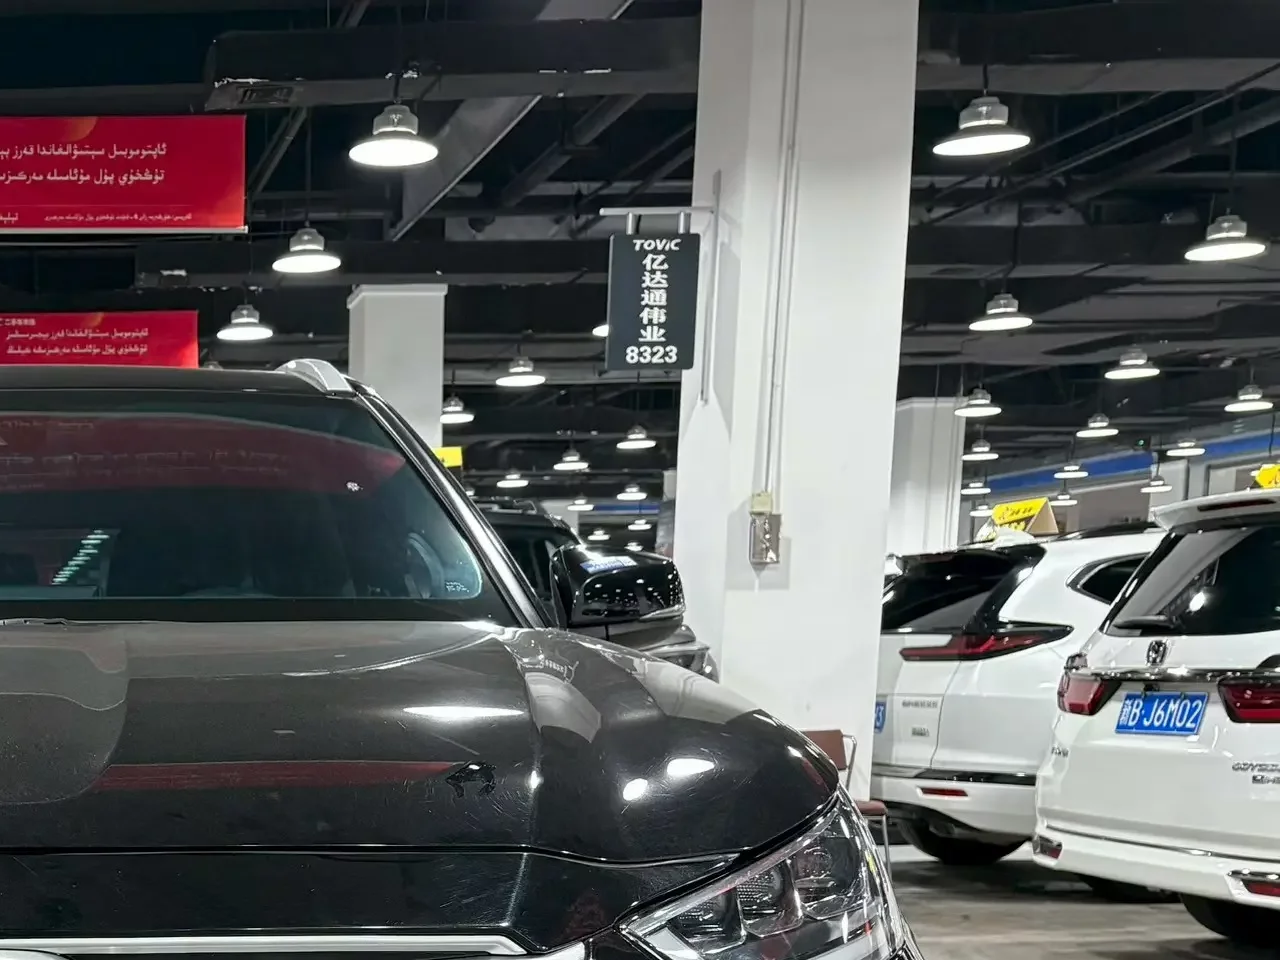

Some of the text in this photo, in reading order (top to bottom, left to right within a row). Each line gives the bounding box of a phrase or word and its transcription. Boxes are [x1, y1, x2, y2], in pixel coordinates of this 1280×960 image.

[632, 239, 682, 251] TOVIC
[638, 253, 670, 343] 亿达通伟业
[625, 345, 678, 364] 8323
